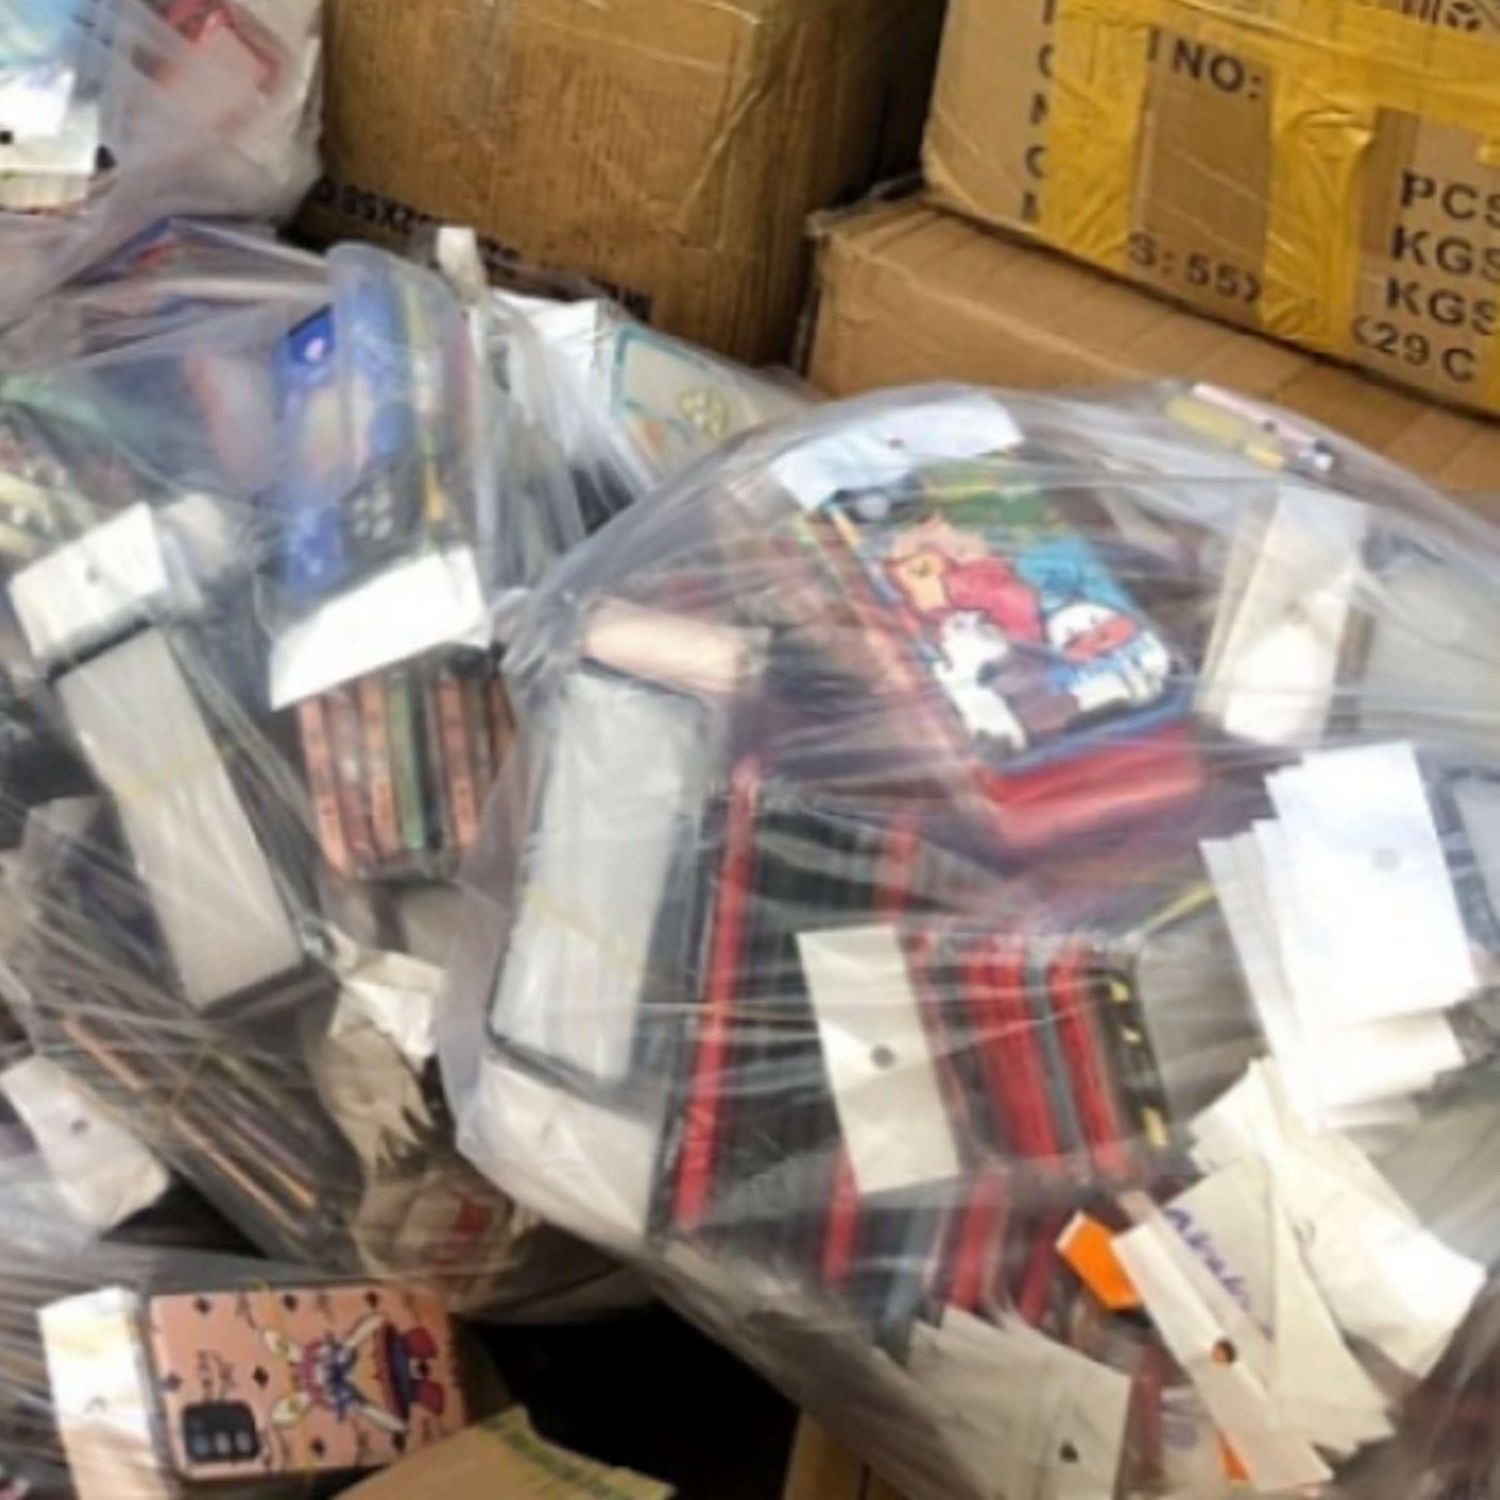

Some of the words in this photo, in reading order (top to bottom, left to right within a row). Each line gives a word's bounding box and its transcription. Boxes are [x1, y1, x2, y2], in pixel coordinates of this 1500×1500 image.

[1173, 37, 1262, 100] NO:
[1391, 224, 1500, 284] KGS
[1386, 277, 1498, 336] KGS
